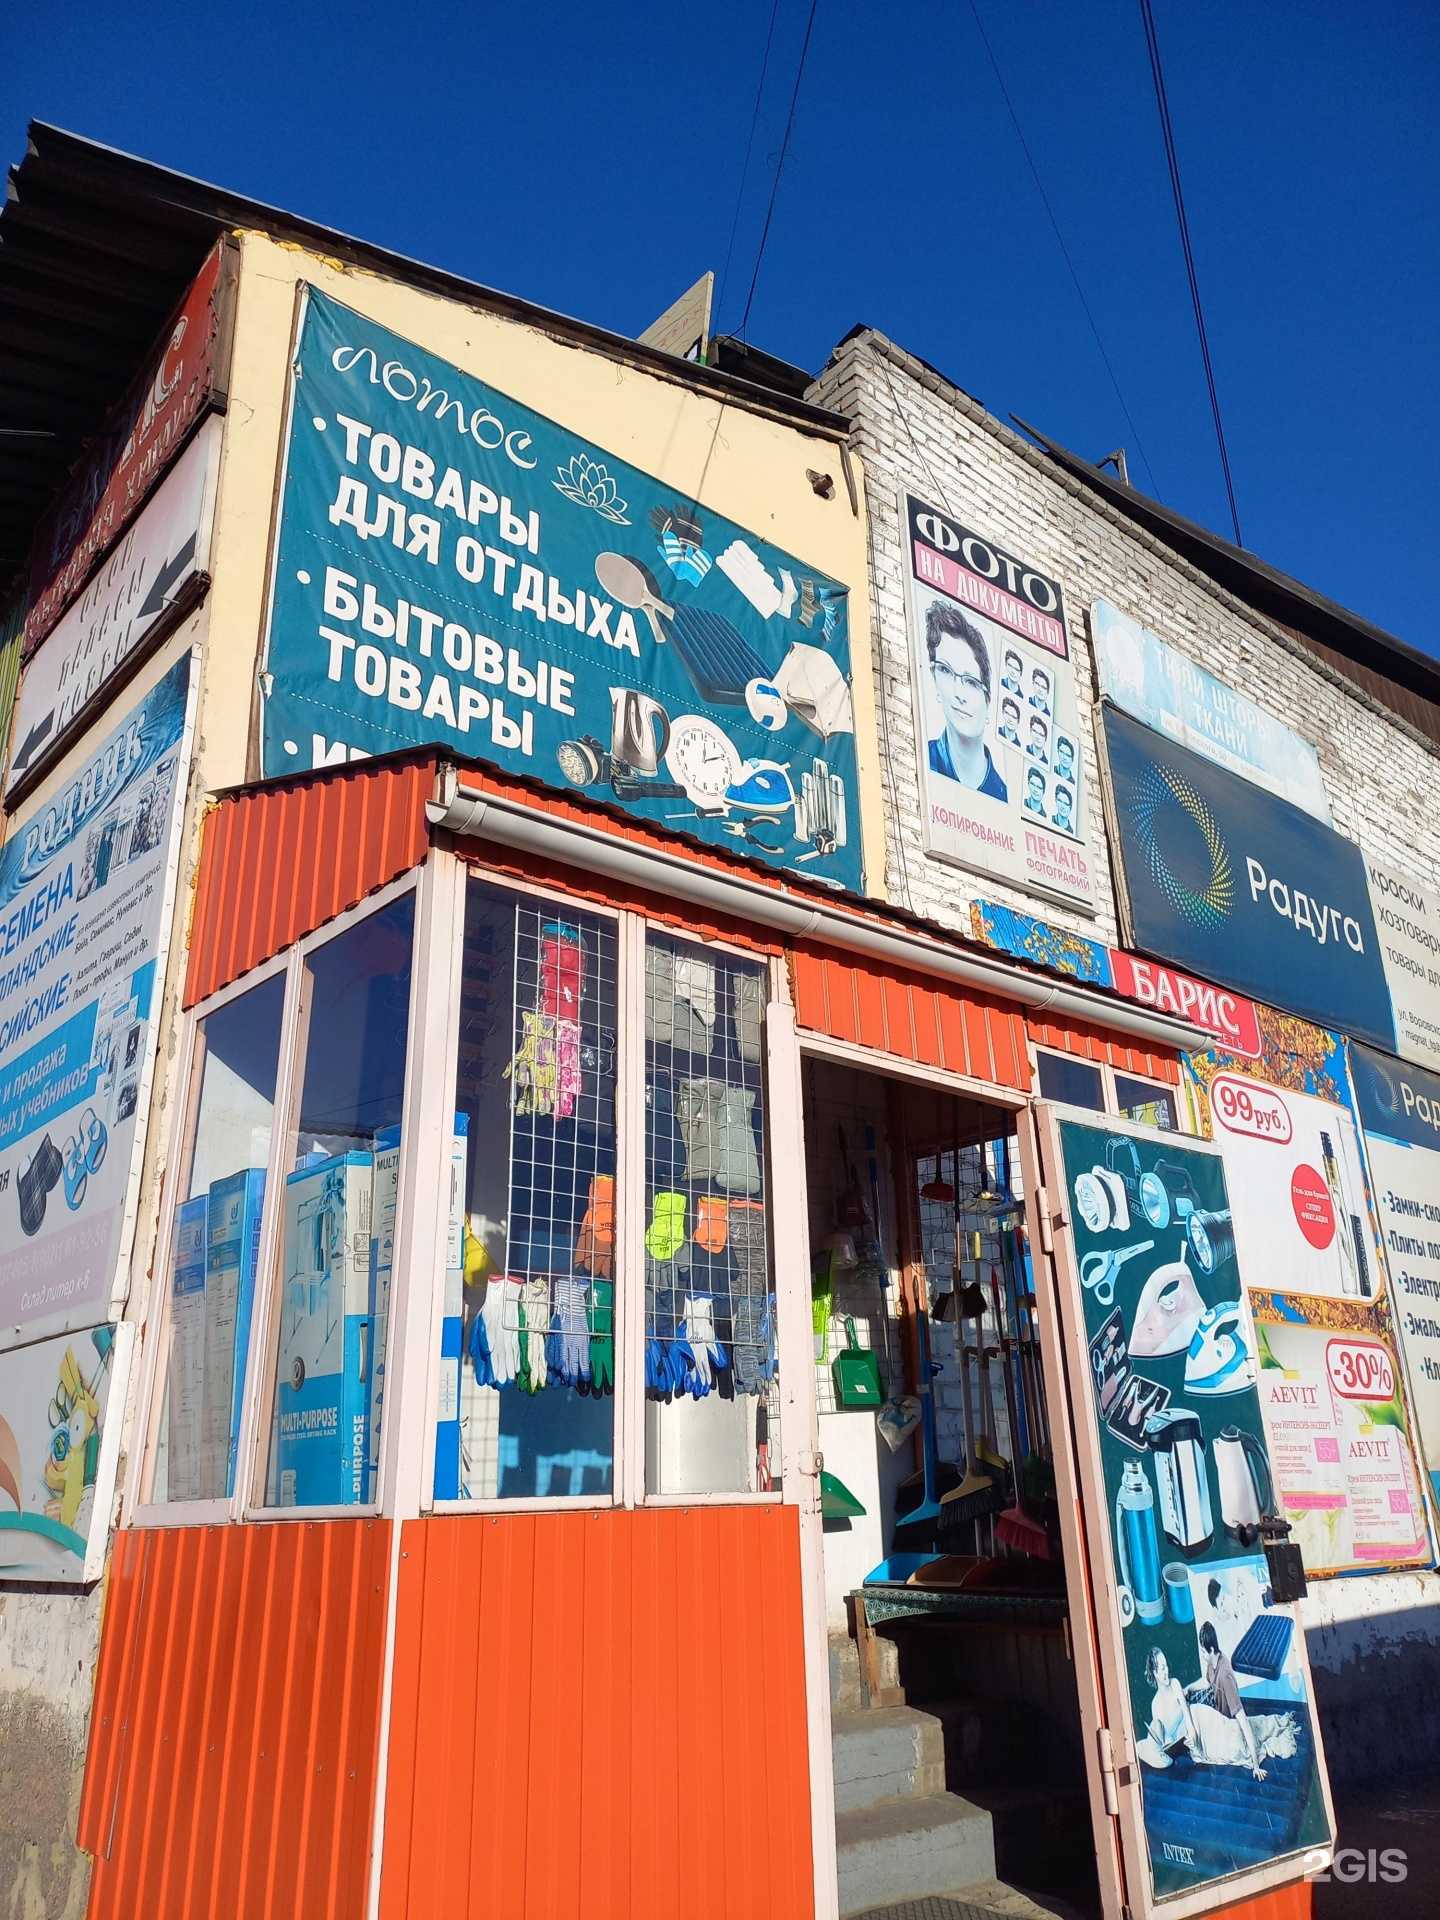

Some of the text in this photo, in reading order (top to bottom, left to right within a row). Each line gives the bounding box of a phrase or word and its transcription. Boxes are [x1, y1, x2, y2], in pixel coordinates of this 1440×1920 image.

[336, 413, 540, 554] ТОВАРЫ
[329, 477, 640, 656] ДЛЯ ОТДЫХА
[916, 513, 1057, 611] ФОТО
[920, 550, 1060, 648] НА ДОКУМЕНТЫ
[324, 567, 575, 716] БЫТОВЫЕ
[318, 626, 534, 755] ТОВАРЫ
[1195, 703, 1249, 757] ТКАНИ
[20, 710, 147, 872] РОДНИК
[932, 804, 1015, 852] КОПИРОВАНИЕ
[1025, 831, 1088, 875] ПЕЧАТЬ
[1246, 856, 1365, 955] Радуга
[1369, 866, 1427, 915] краски
[1386, 946, 1427, 979] товары
[1129, 959, 1241, 1036] БАРИС
[3, 1043, 67, 1105] и продажа
[18, 1063, 89, 1134] учебников
[1390, 1229, 1426, 1257] Плиты
[1270, 1385, 1317, 1404] AEVIT
[1334, 1351, 1391, 1390] -30%
[281, 1406, 338, 1433] MULTI-PURPOSE
[1349, 1440, 1389, 1458] AEVIT
[1162, 1842, 1195, 1866] INTEX
